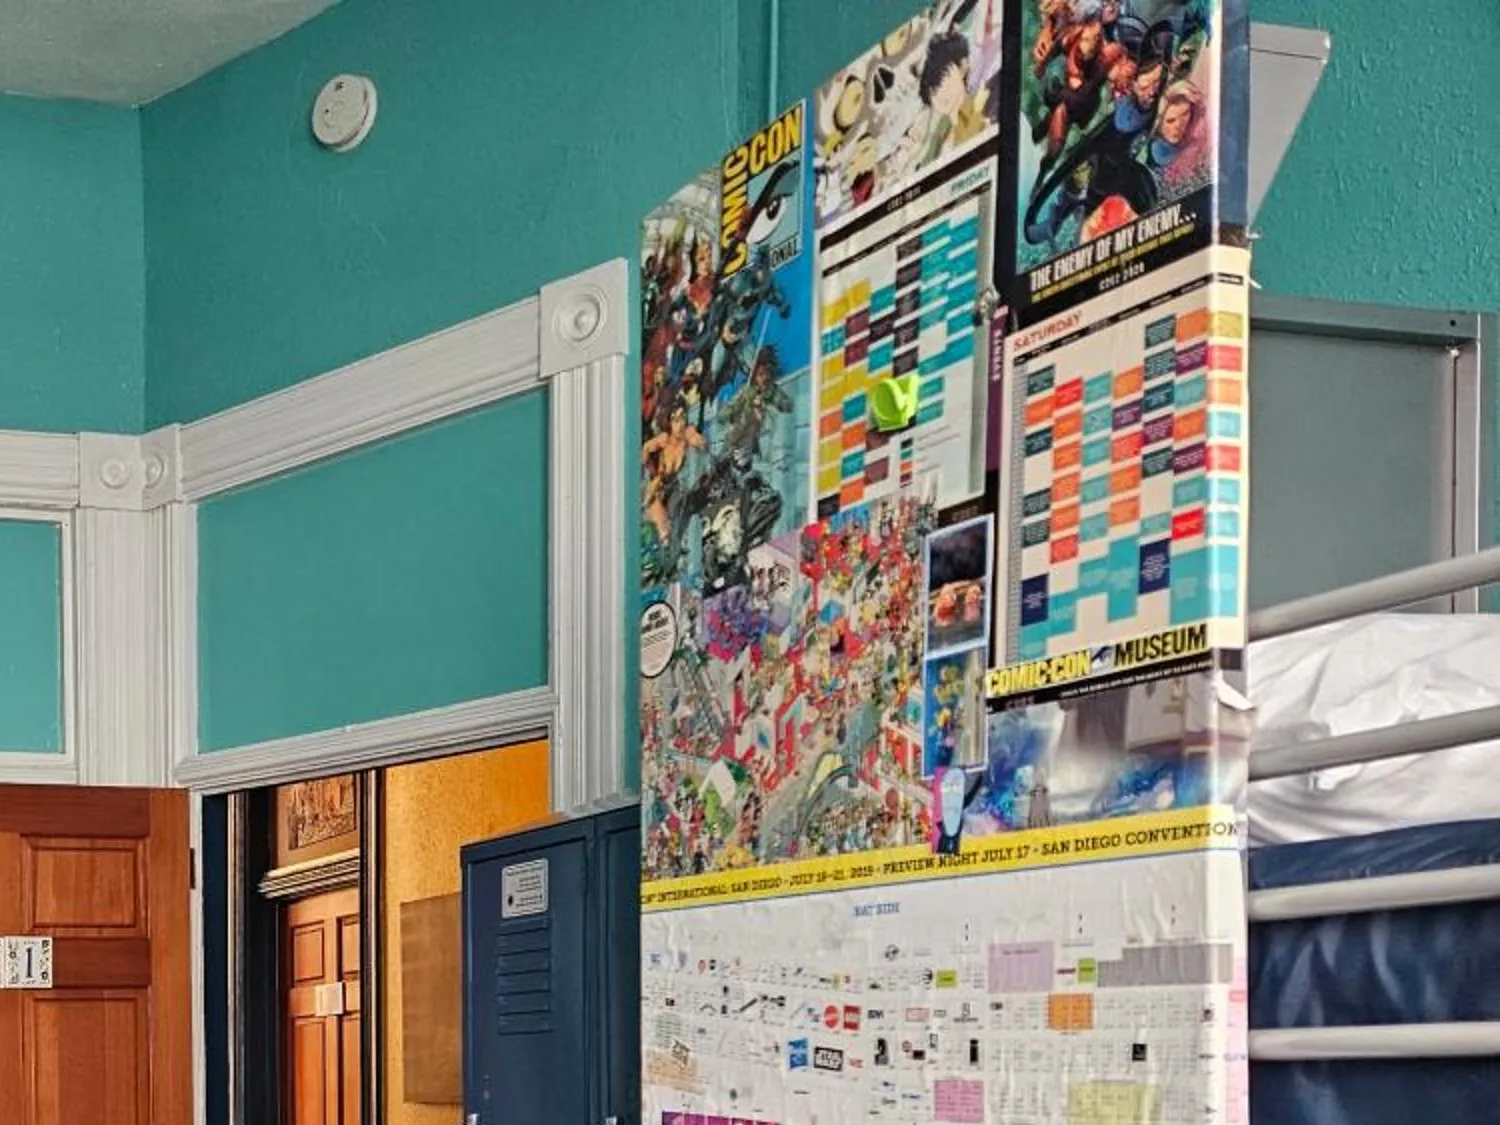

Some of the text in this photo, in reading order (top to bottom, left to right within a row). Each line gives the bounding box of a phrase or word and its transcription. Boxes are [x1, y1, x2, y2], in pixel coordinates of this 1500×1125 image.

[749, 106, 801, 175] CON
[1030, 203, 1197, 291] THE ENEMY OF MY ENEMY...
[1013, 309, 1084, 351] SATURDAY
[986, 649, 1092, 696] COMIC-CON
[1113, 623, 1208, 668] MUSEUM
[883, 857, 935, 876] PREVIEW
[937, 851, 979, 869] NIGHT
[981, 845, 1015, 864] JULY
[1016, 844, 1031, 860] 17
[1041, 839, 1071, 858] SAN
[1074, 833, 1122, 851] DIEGO
[1125, 821, 1241, 846] CONVENTION
